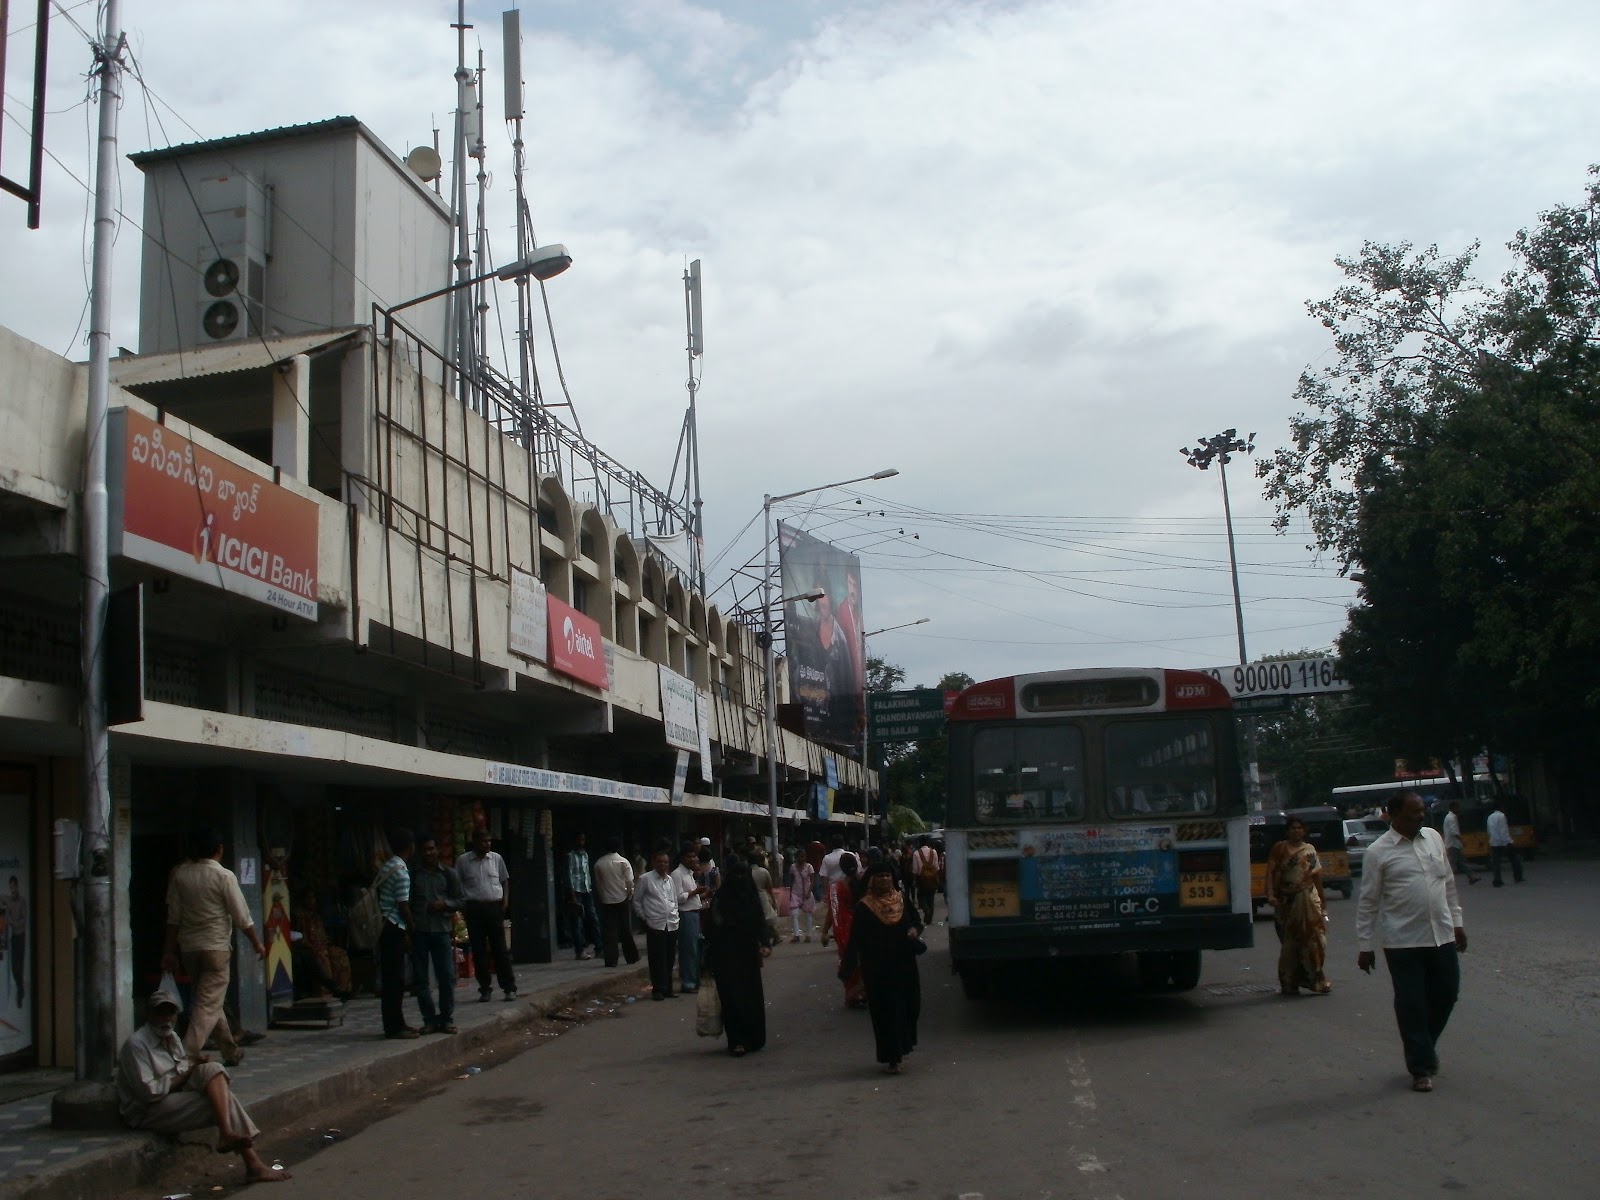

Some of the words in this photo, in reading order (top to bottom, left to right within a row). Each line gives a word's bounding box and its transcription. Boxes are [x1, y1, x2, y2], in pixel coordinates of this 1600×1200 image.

[217, 533, 269, 579] ICICI
[271, 555, 314, 597] Bank
[266, 590, 277, 602] 24
[278, 594, 296, 610] Hour
[297, 600, 314, 616] ATM
[575, 628, 595, 660] airtel
[1177, 686, 1206, 697] JDM
[1234, 663, 1291, 693] 90000
[875, 710, 944, 723] CHANDRAYANGUTT
